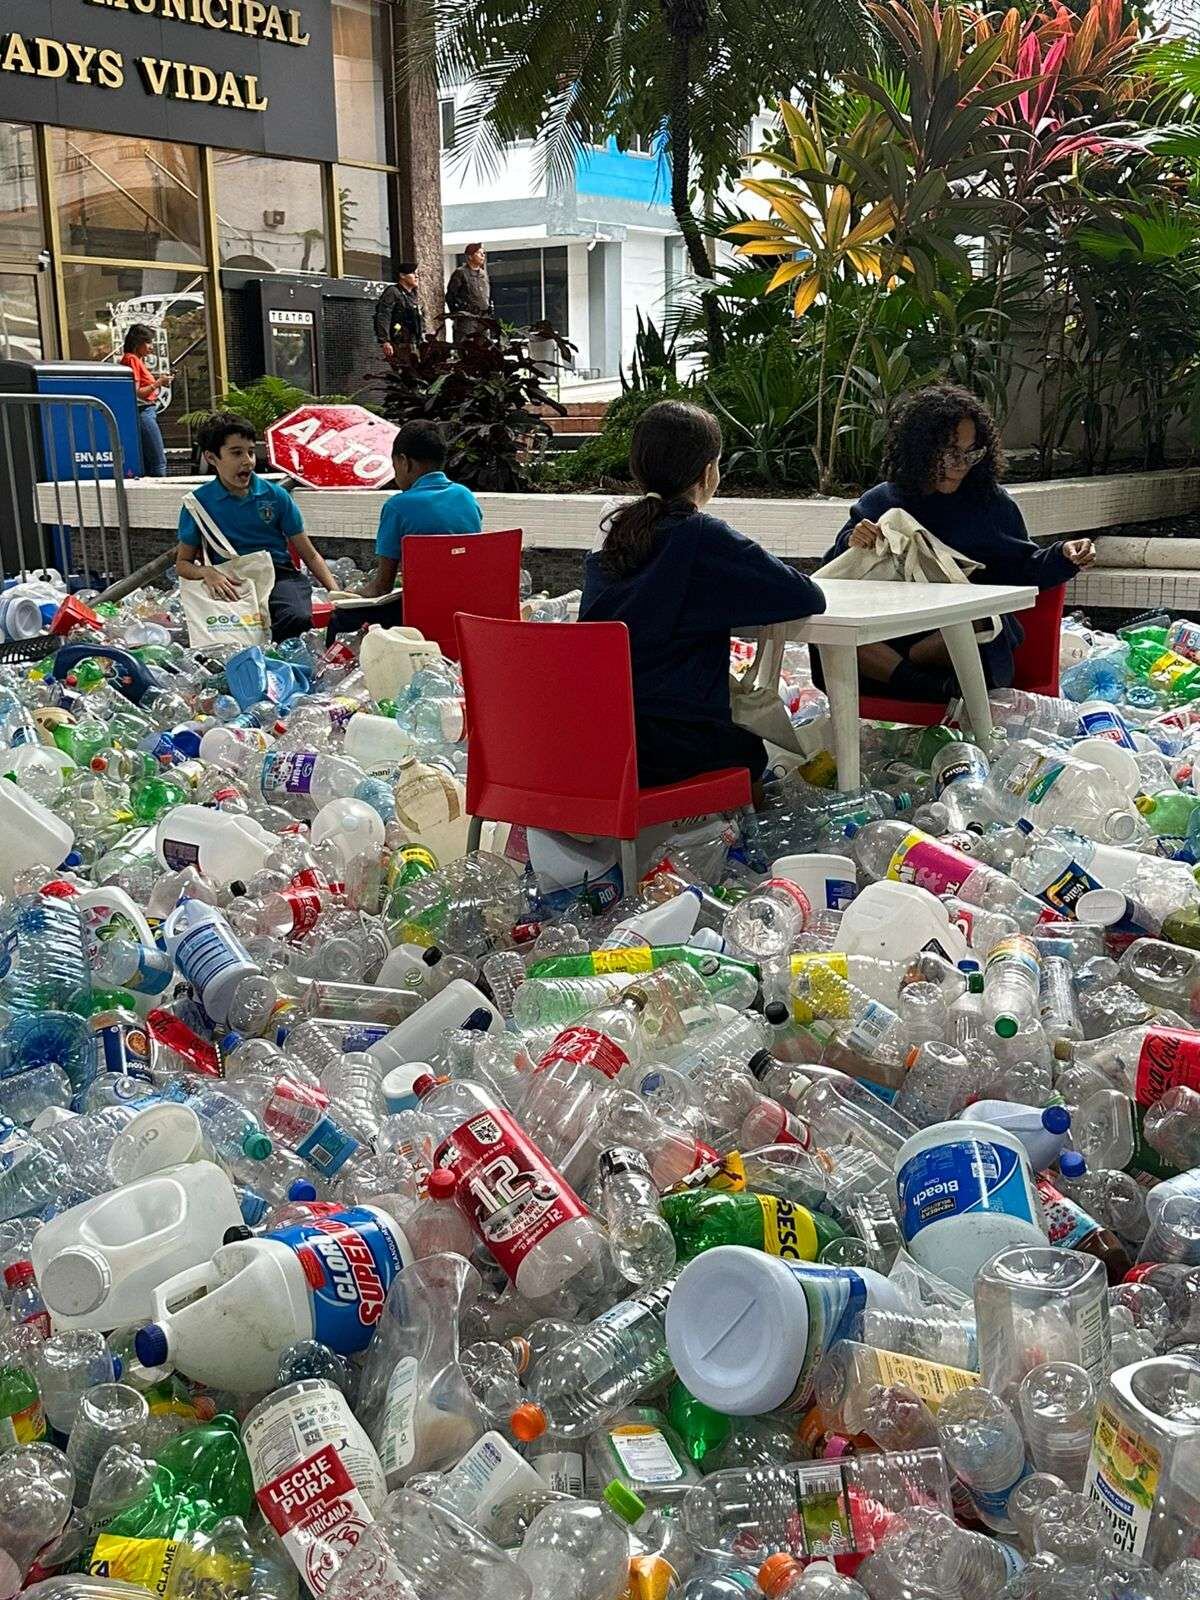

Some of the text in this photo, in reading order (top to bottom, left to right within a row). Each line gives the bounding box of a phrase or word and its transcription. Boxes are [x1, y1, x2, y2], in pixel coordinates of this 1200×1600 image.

[92, 0, 310, 46] NICIPAL
[0, 33, 268, 111] ADYS VIDAL
[271, 312, 311, 322] TEATRO
[278, 417, 389, 479] ALTO
[1062, 883, 1085, 903] Valle
[469, 1155, 531, 1215] 12
[913, 1180, 959, 1206] Bleach
[326, 1223, 385, 1326] SUPER
[269, 1455, 332, 1503] LECHE
[281, 1475, 336, 1514] PURA
[298, 1506, 351, 1544] HIRICANA
[311, 1503, 325, 1518] LA
[158, 1544, 177, 1596] CLAME
